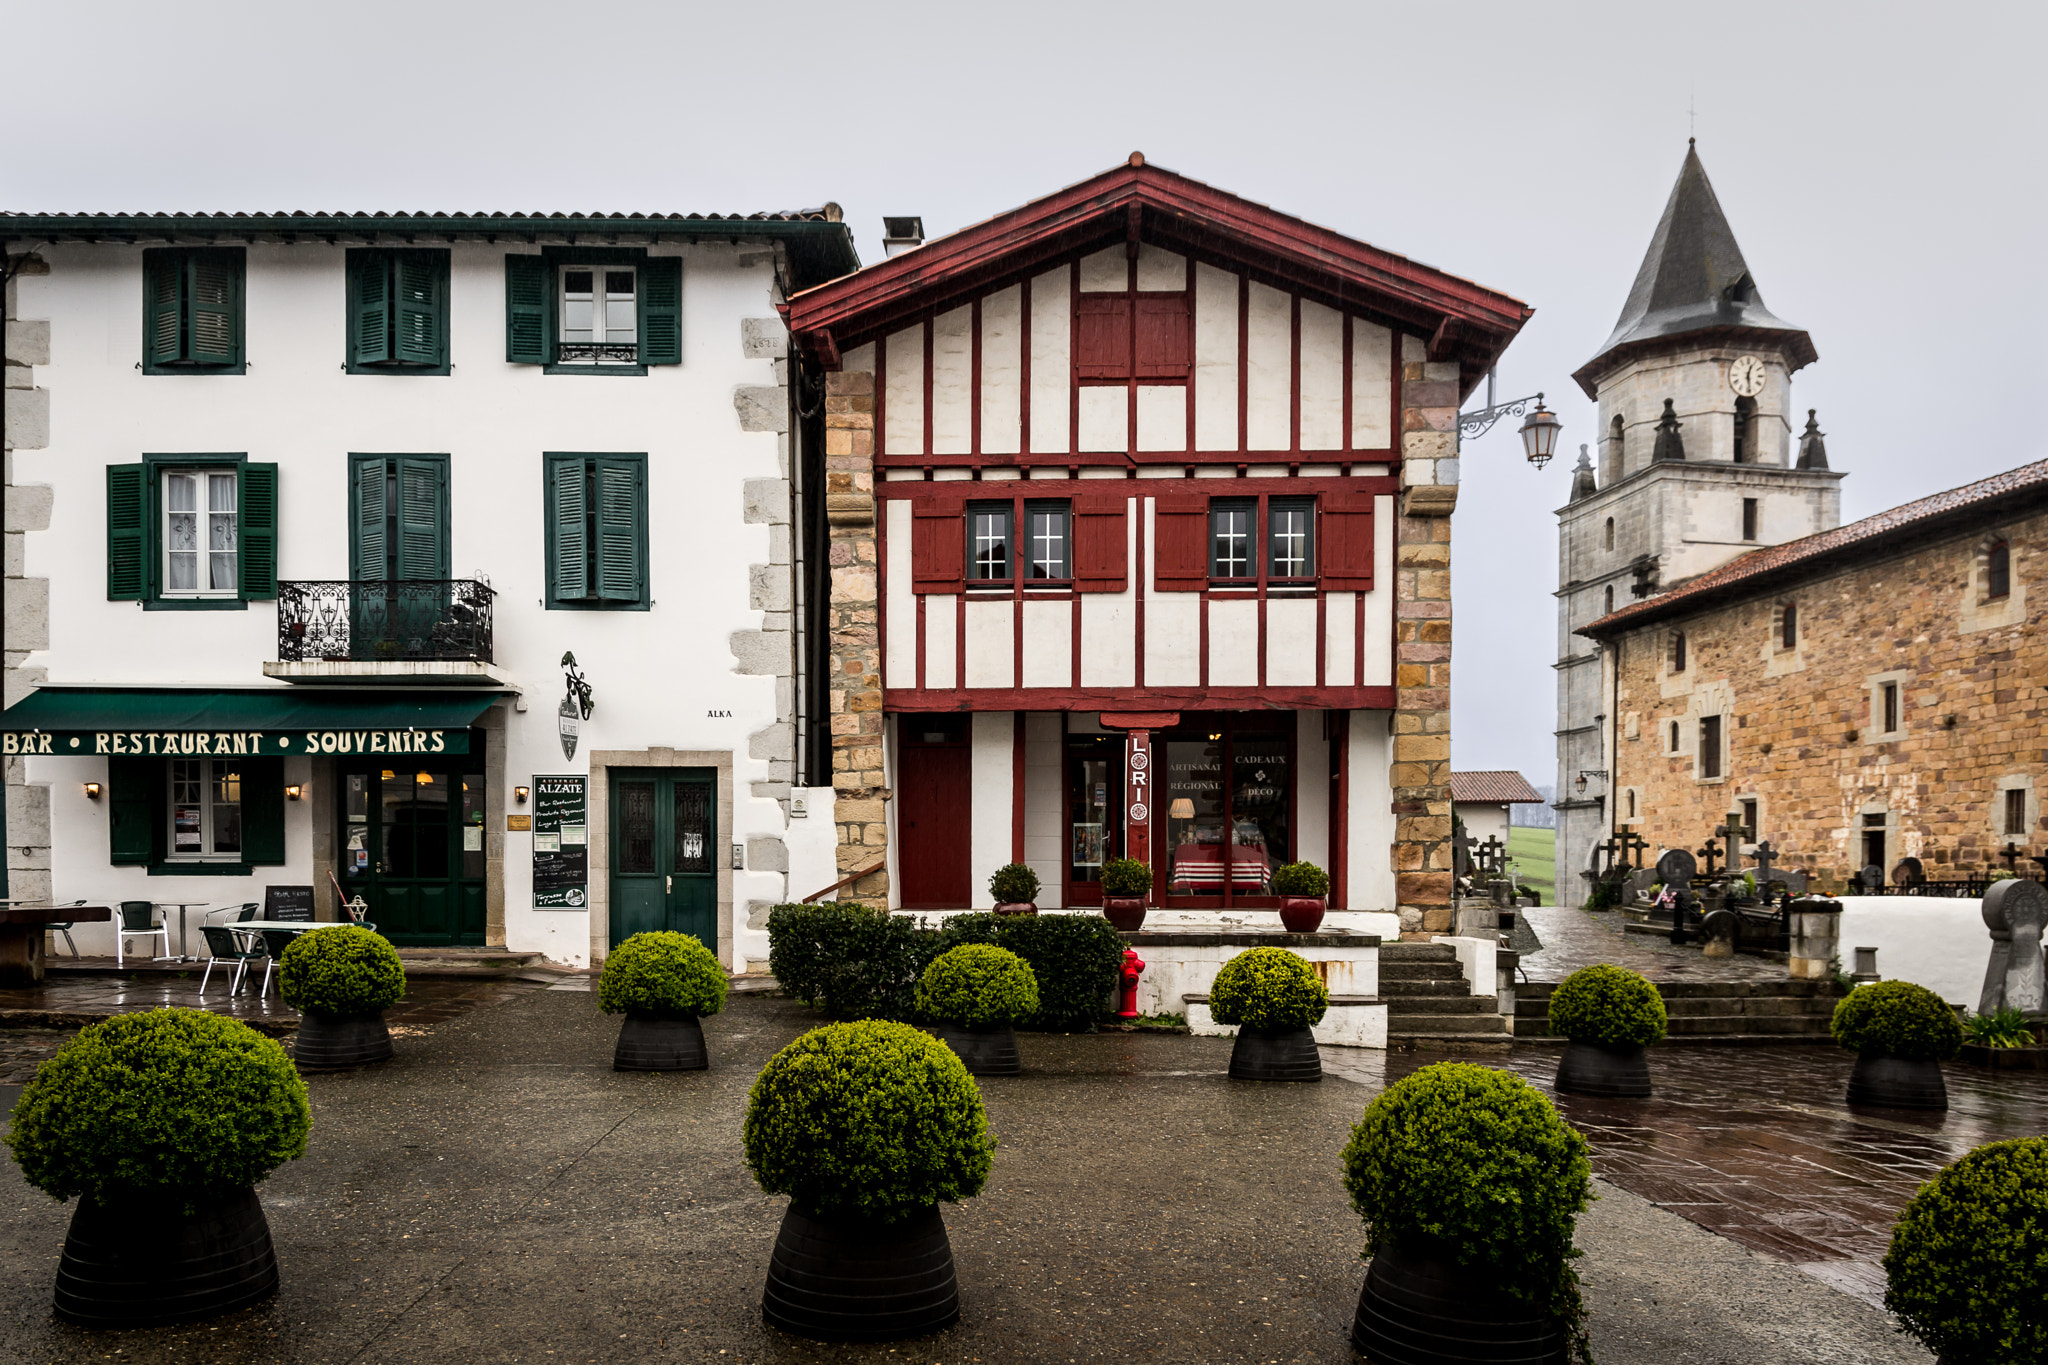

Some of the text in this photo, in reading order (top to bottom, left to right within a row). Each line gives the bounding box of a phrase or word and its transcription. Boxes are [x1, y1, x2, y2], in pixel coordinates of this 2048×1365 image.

[707, 710, 732, 718] ALKA
[2, 730, 446, 754] BAR RESTAURANT SOUVENIRS
[1234, 755, 1286, 764] CADEAUX
[1169, 763, 1222, 771] ARTISANAT
[538, 784, 583, 794] ALZATE
[1170, 780, 1222, 790] RÉGIONAL
[1248, 786, 1274, 796] DÉCO
